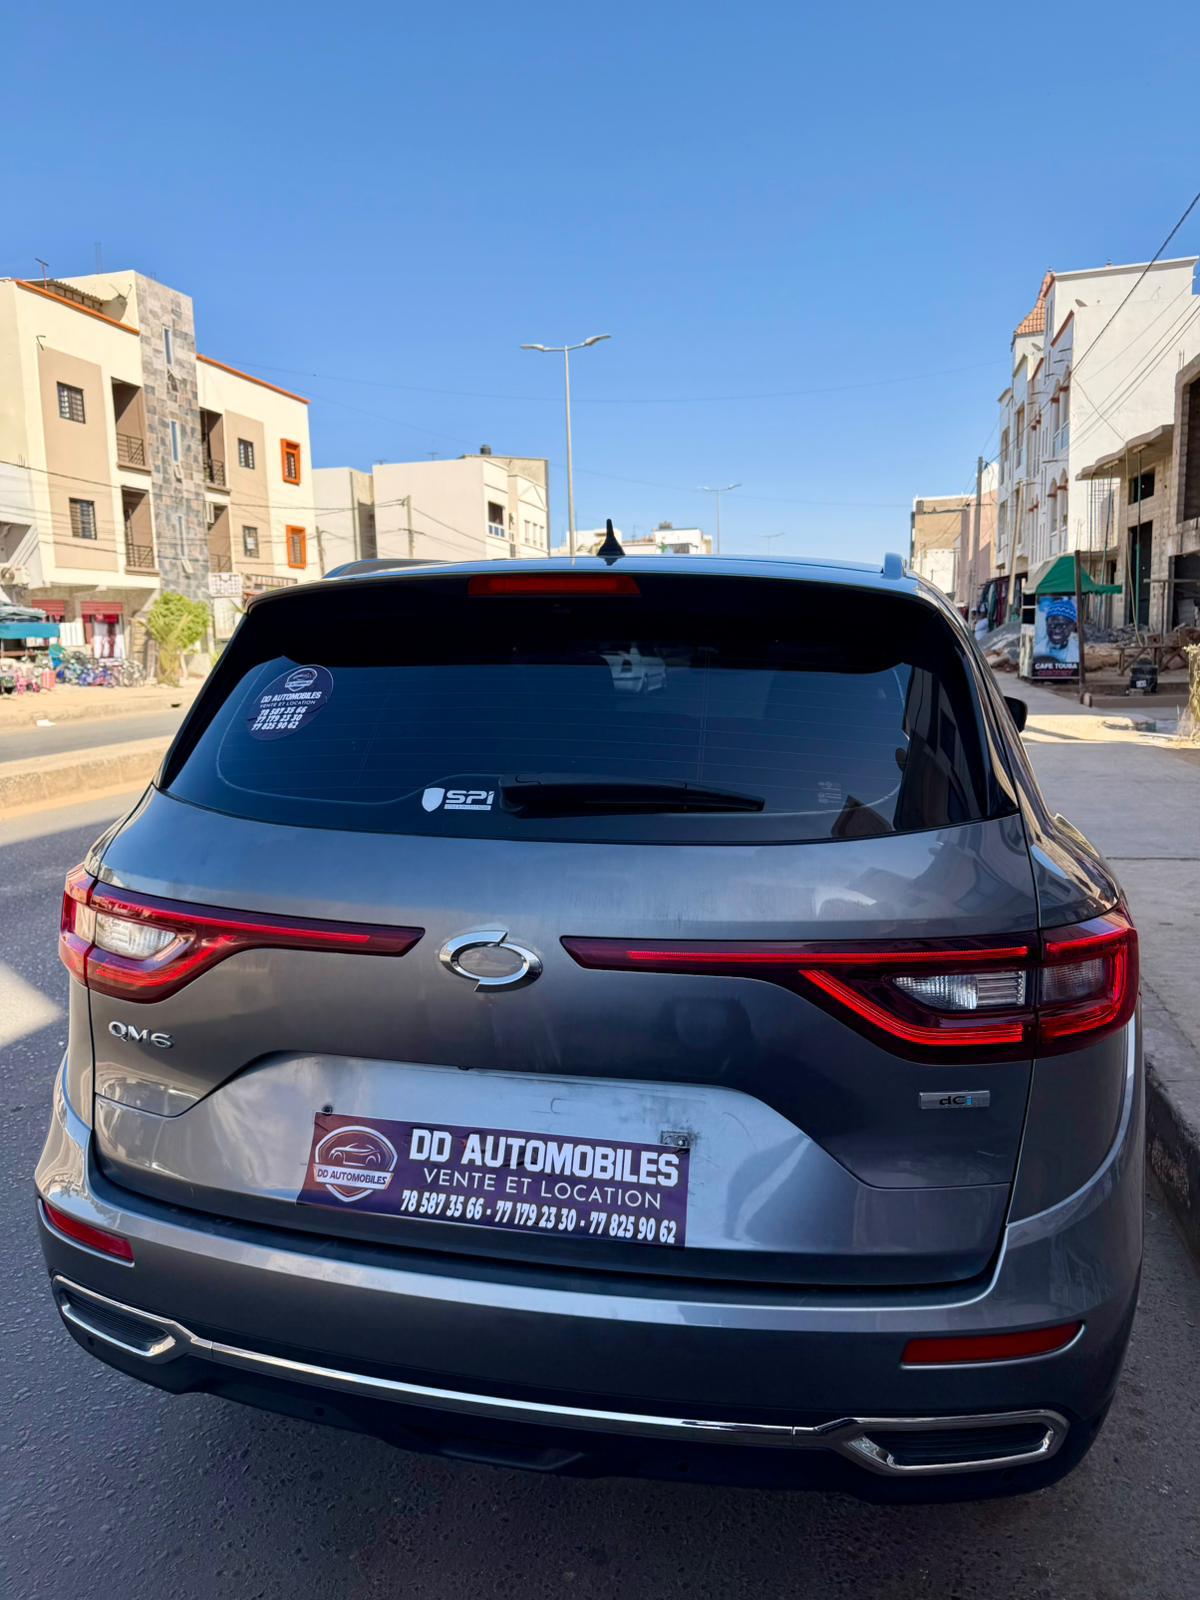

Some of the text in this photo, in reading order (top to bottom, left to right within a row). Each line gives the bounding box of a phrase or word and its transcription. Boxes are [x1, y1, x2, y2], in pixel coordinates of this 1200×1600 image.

[261, 692, 321, 703] DD AUTOMOBILES
[269, 707, 285, 716] 587
[285, 706, 296, 714] 35
[296, 706, 308, 714] 66
[251, 723, 263, 731] 77
[287, 721, 299, 729] 62
[409, 1128, 679, 1187] DD AUTOMOBILES
[317, 1168, 387, 1185] DD AUTOMOBILES
[424, 1167, 661, 1210] VENTE ET LOCATION
[400, 1189, 419, 1212] 78
[419, 1191, 446, 1215] 587
[445, 1194, 465, 1217] 35
[465, 1197, 485, 1220] 66
[494, 1200, 513, 1223] 77
[514, 1202, 537, 1226] 179
[538, 1205, 557, 1229] 23
[557, 1207, 577, 1231] 30
[588, 1211, 607, 1235] 77
[608, 1213, 635, 1238] 825
[637, 1216, 656, 1241] 90
[659, 1219, 677, 1243] 62
